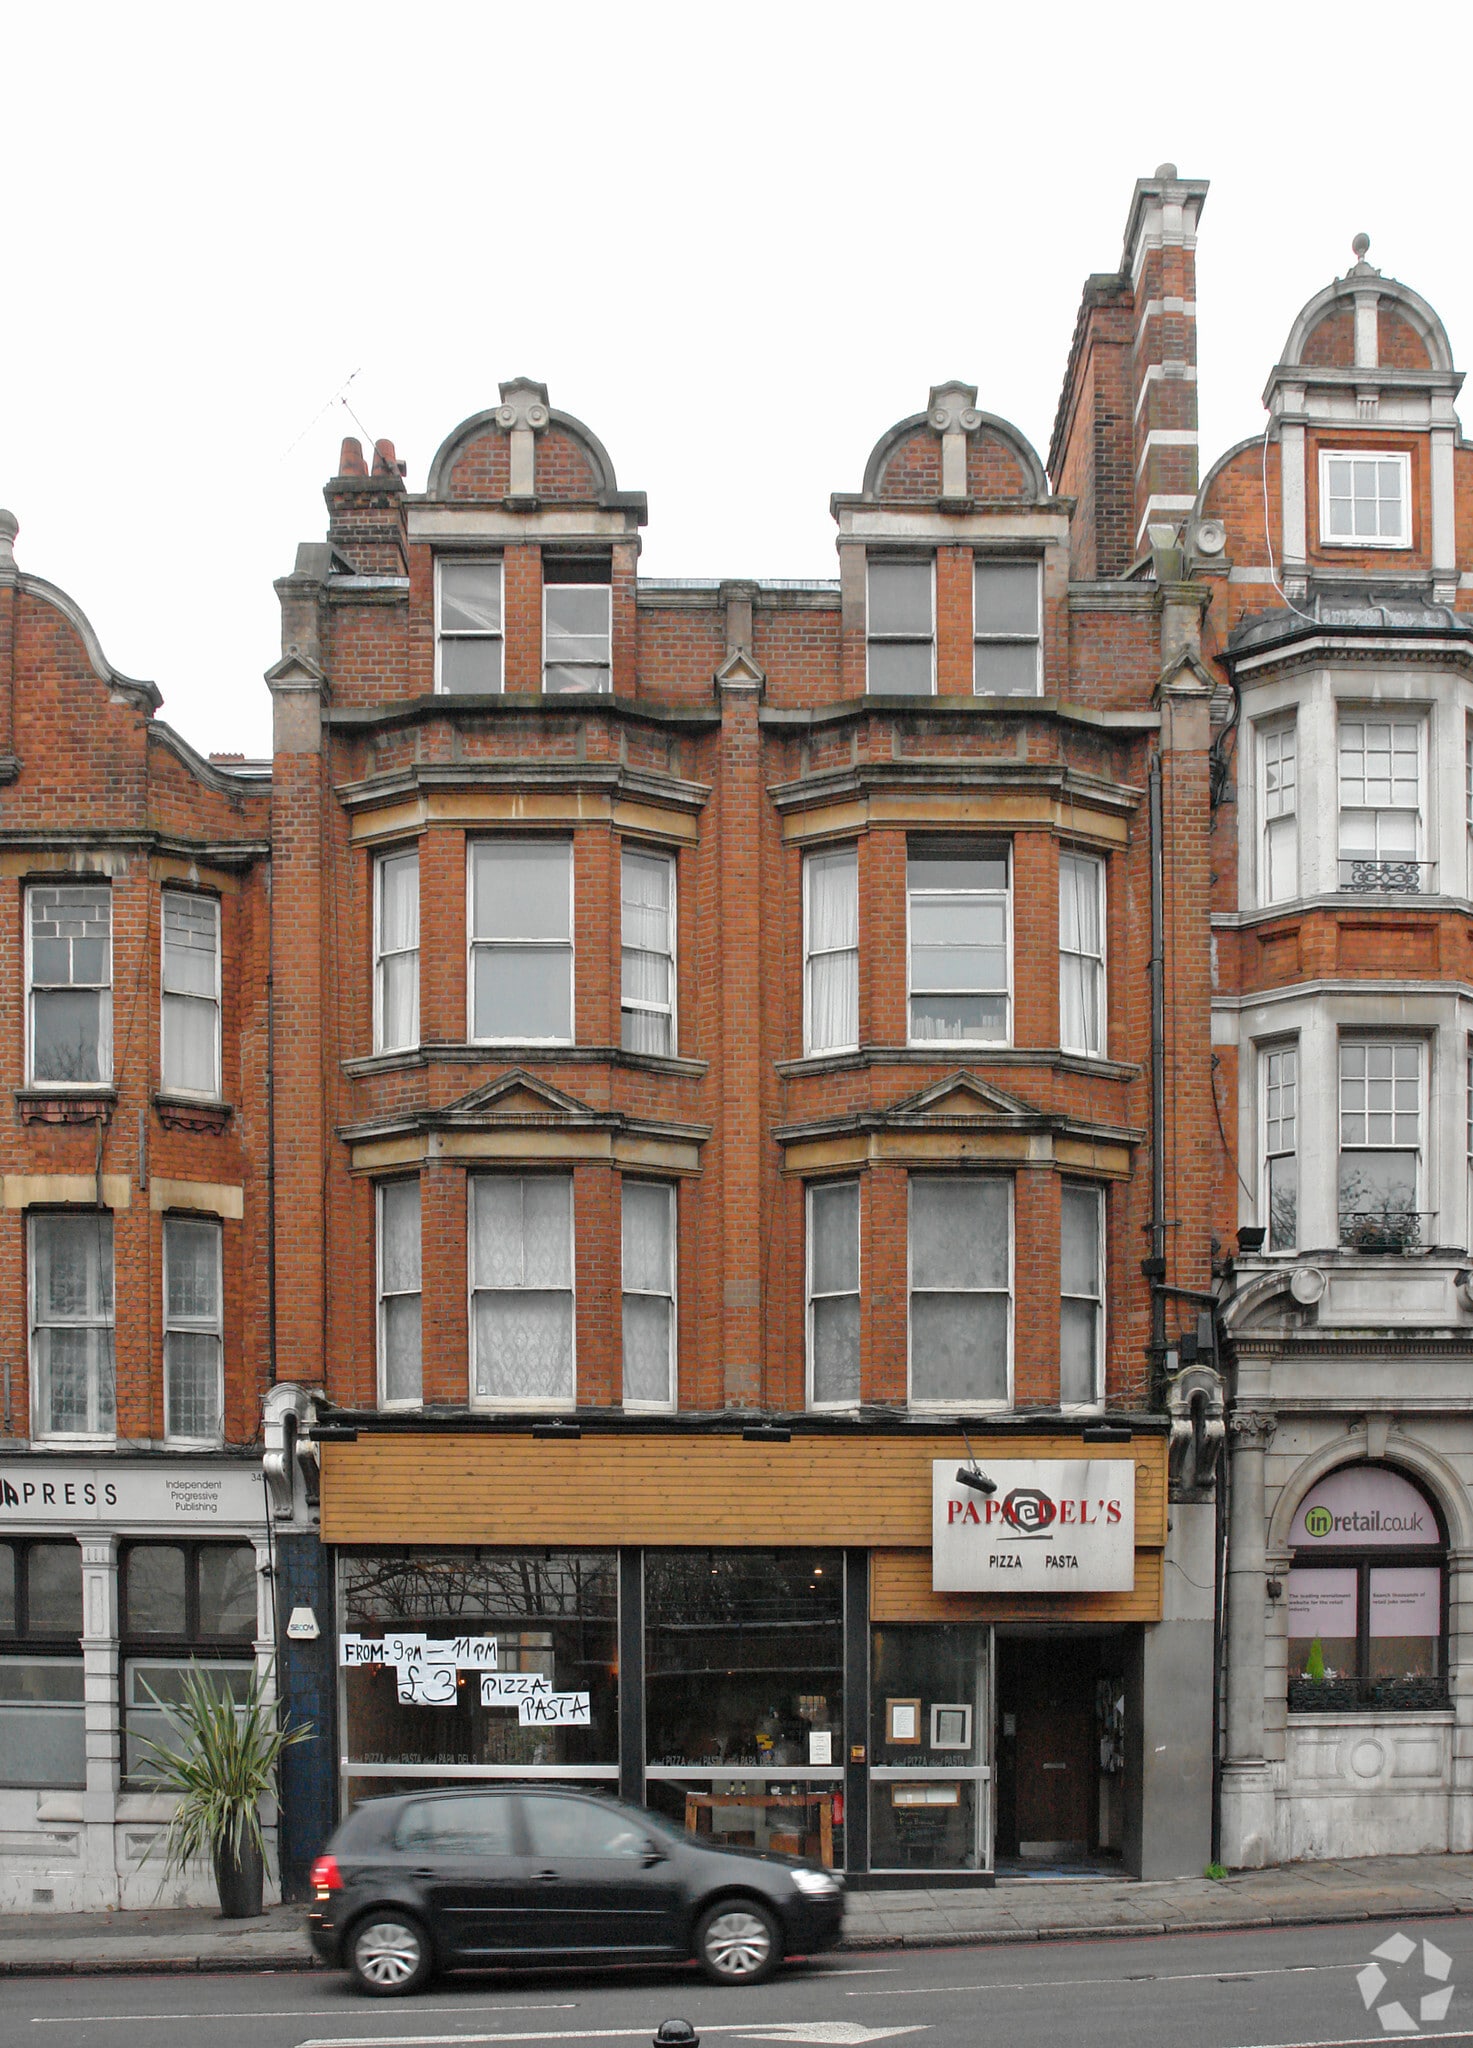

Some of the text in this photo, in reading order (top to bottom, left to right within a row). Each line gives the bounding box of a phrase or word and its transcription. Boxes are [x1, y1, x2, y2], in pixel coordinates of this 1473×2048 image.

[165, 1480, 222, 1490] Independent
[170, 1490, 219, 1501] Progressive
[175, 1502, 218, 1513] Publishing
[989, 1555, 1079, 1569] PIZZA PASTA
[290, 1623, 315, 1632] SECOM
[397, 1664, 456, 1703] £3
[482, 1677, 549, 1701] PIZZA
[520, 1694, 590, 1721] PASTA
